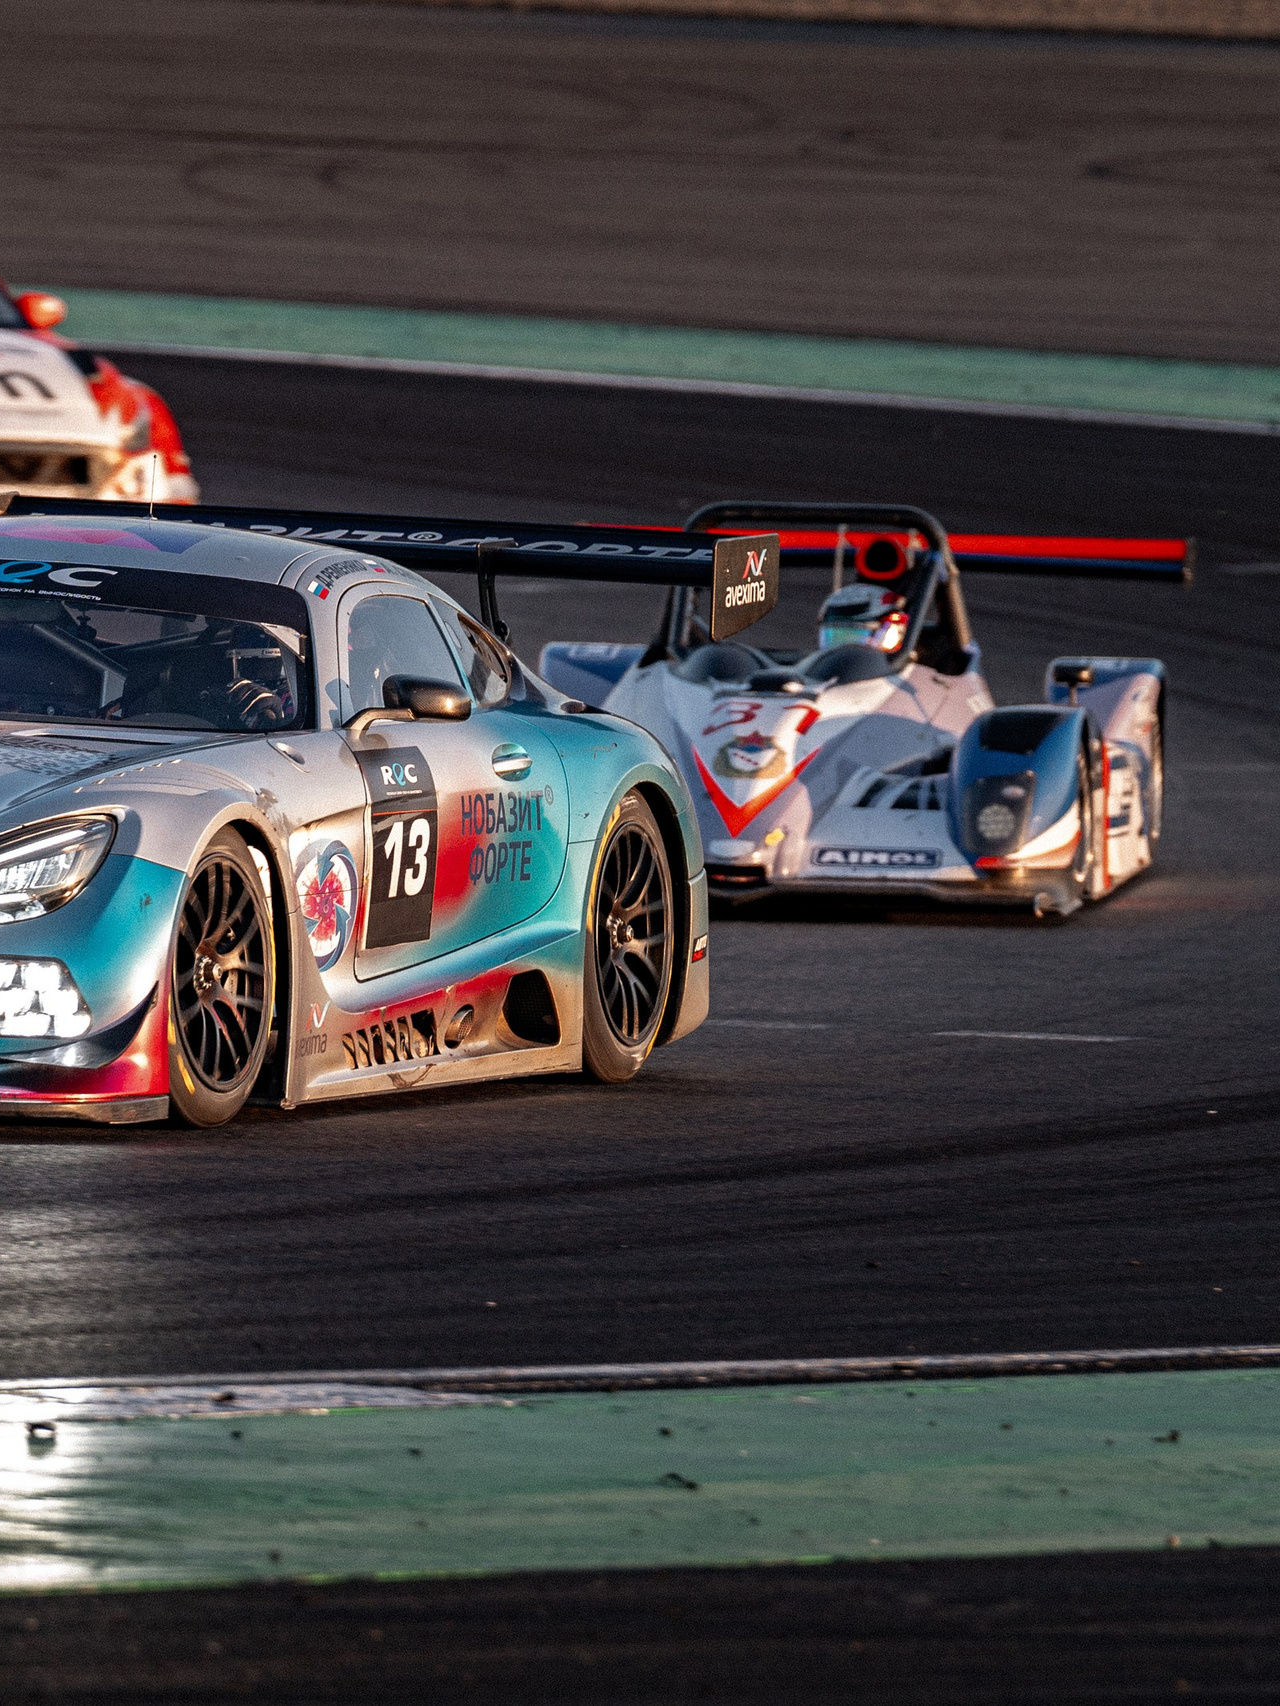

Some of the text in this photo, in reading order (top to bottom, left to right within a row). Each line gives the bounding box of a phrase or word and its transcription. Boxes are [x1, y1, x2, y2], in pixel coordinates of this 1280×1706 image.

[725, 577, 766, 608] avexima
[383, 817, 431, 898] 13
[470, 840, 532, 886] ФОРТЕ
